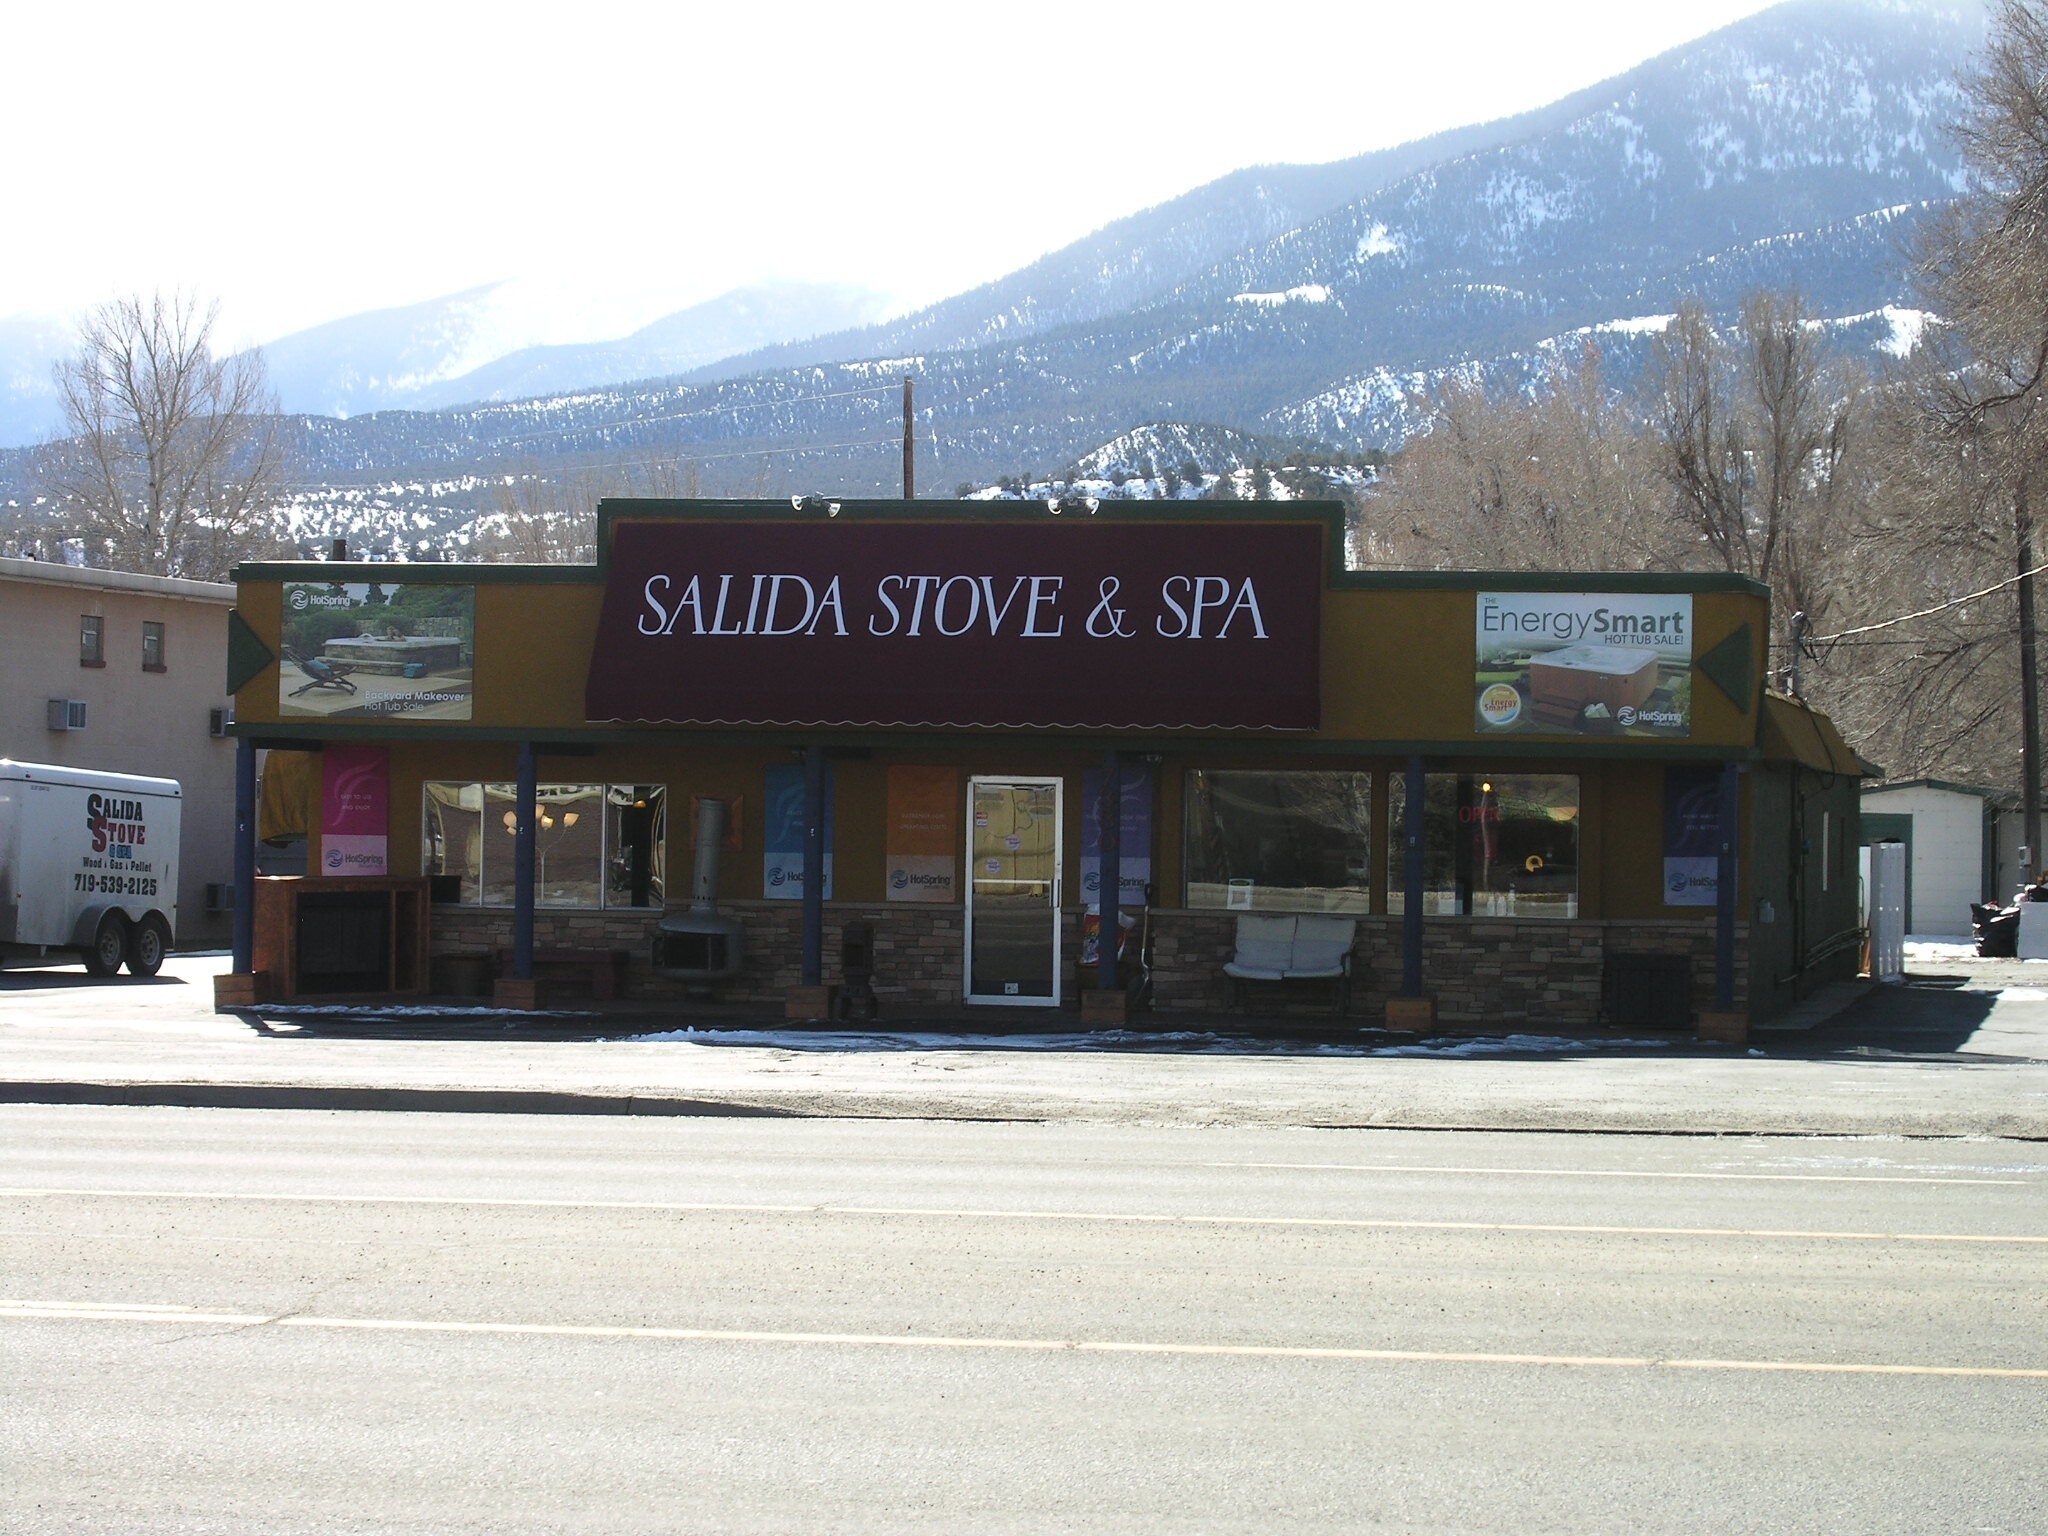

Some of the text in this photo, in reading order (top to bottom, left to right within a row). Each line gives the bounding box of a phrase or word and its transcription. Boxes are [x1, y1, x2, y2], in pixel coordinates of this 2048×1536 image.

[310, 594, 351, 607] HotSpring
[637, 574, 1269, 639] SALIDA STOVE & SPA
[1604, 634, 1684, 645] HOT TUB SALE!
[365, 690, 465, 701] Backyard Makeover
[364, 702, 424, 711] Hot Tub Sale
[1639, 711, 1682, 723] HotSpring
[87, 793, 143, 830] SALIDA
[92, 814, 146, 853] STOVE
[83, 857, 152, 873] Wood Gas Pellet
[345, 853, 383, 865] HotSpring
[74, 873, 157, 897] 719-539-2125
[910, 874, 950, 886] HotSpring
